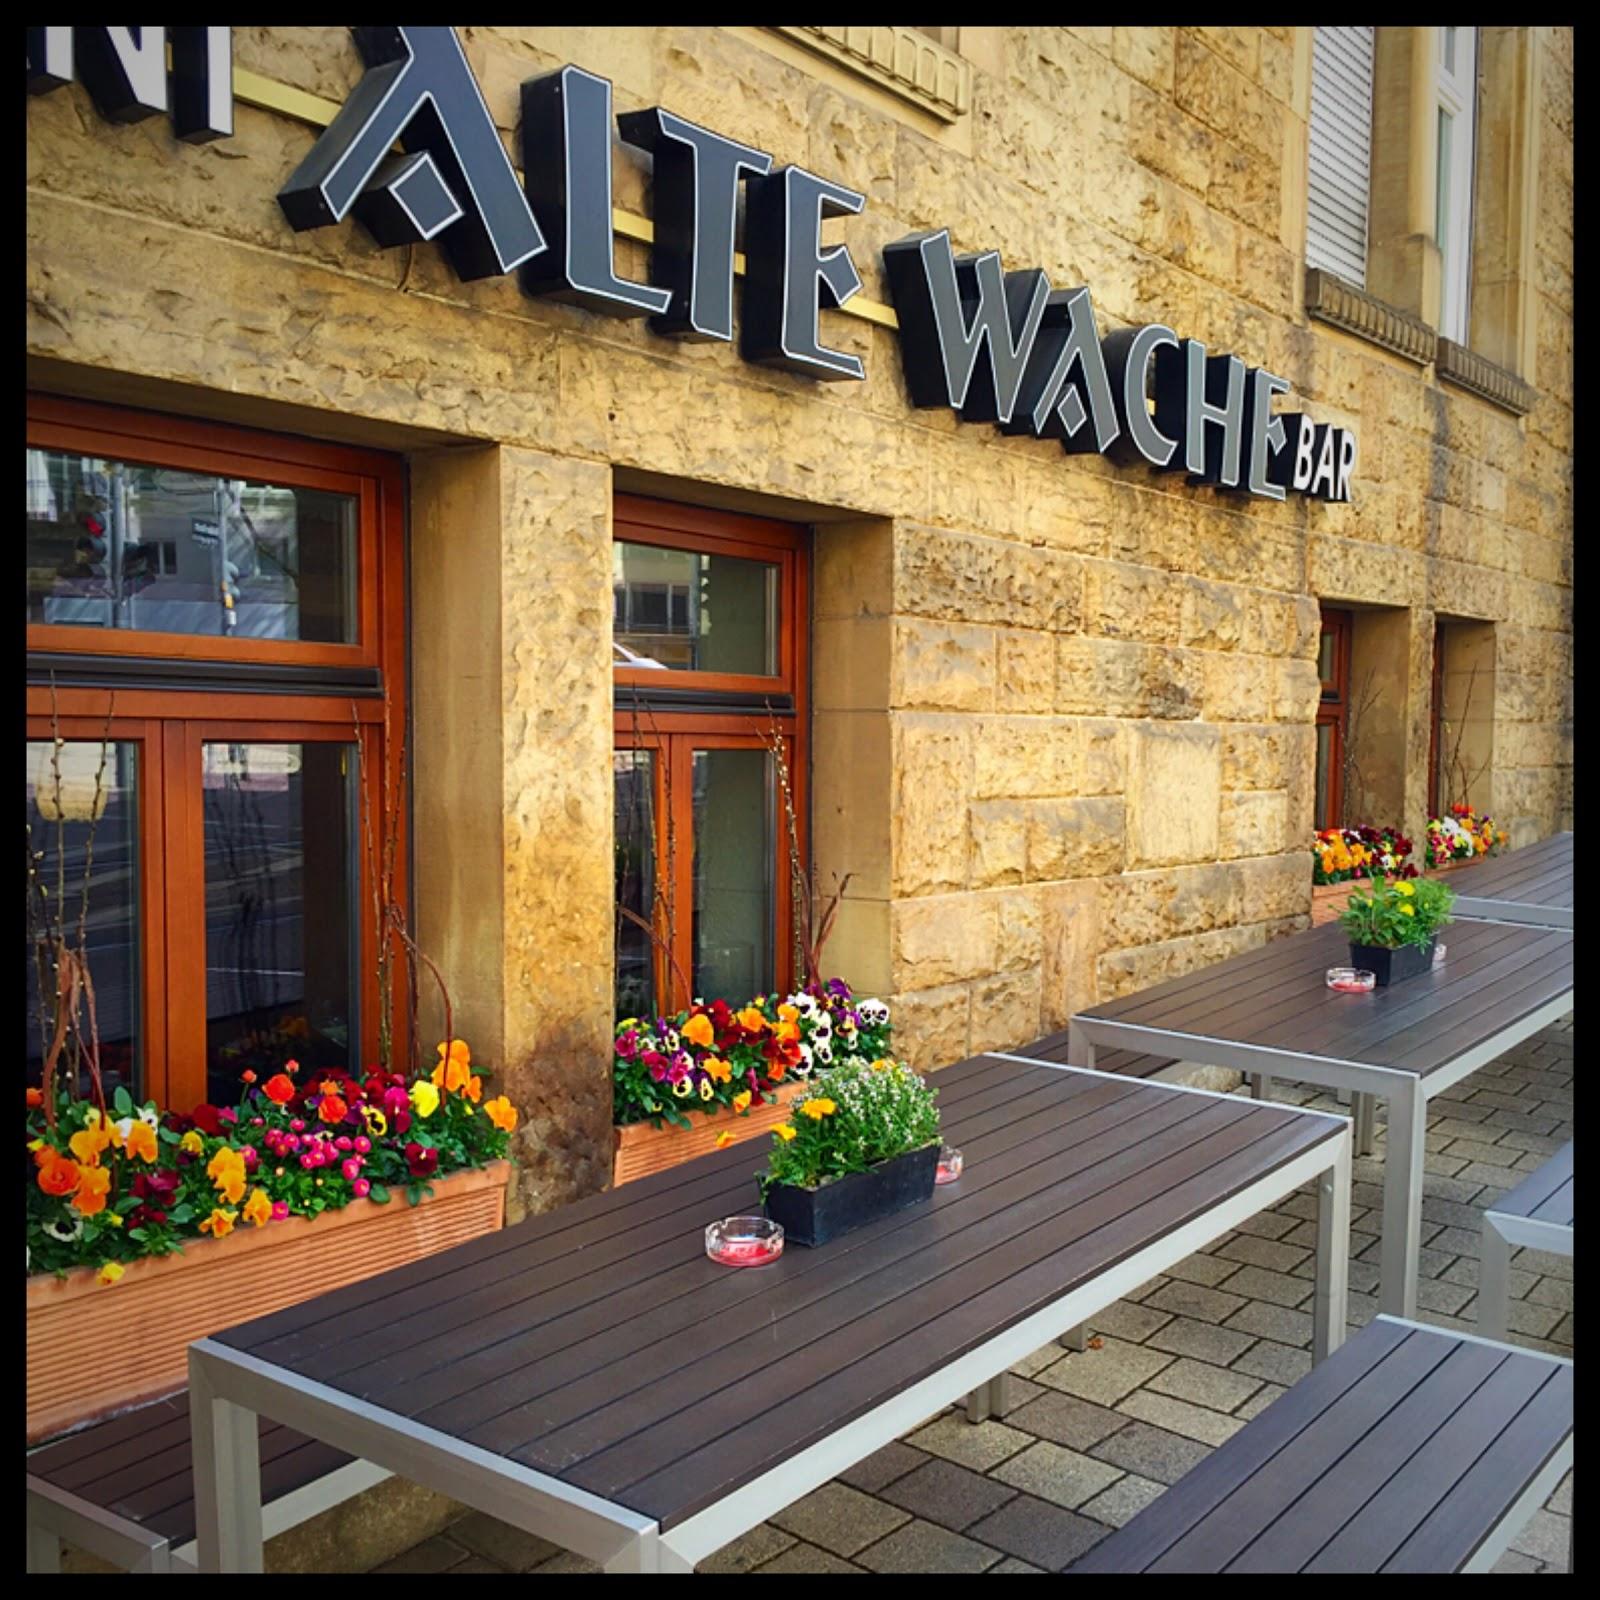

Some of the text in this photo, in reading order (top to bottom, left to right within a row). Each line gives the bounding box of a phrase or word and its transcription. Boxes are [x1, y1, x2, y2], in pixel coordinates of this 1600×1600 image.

[319, 27, 866, 379] ALTE
[919, 229, 1290, 501] WACHE
[1294, 419, 1356, 502] BAR
